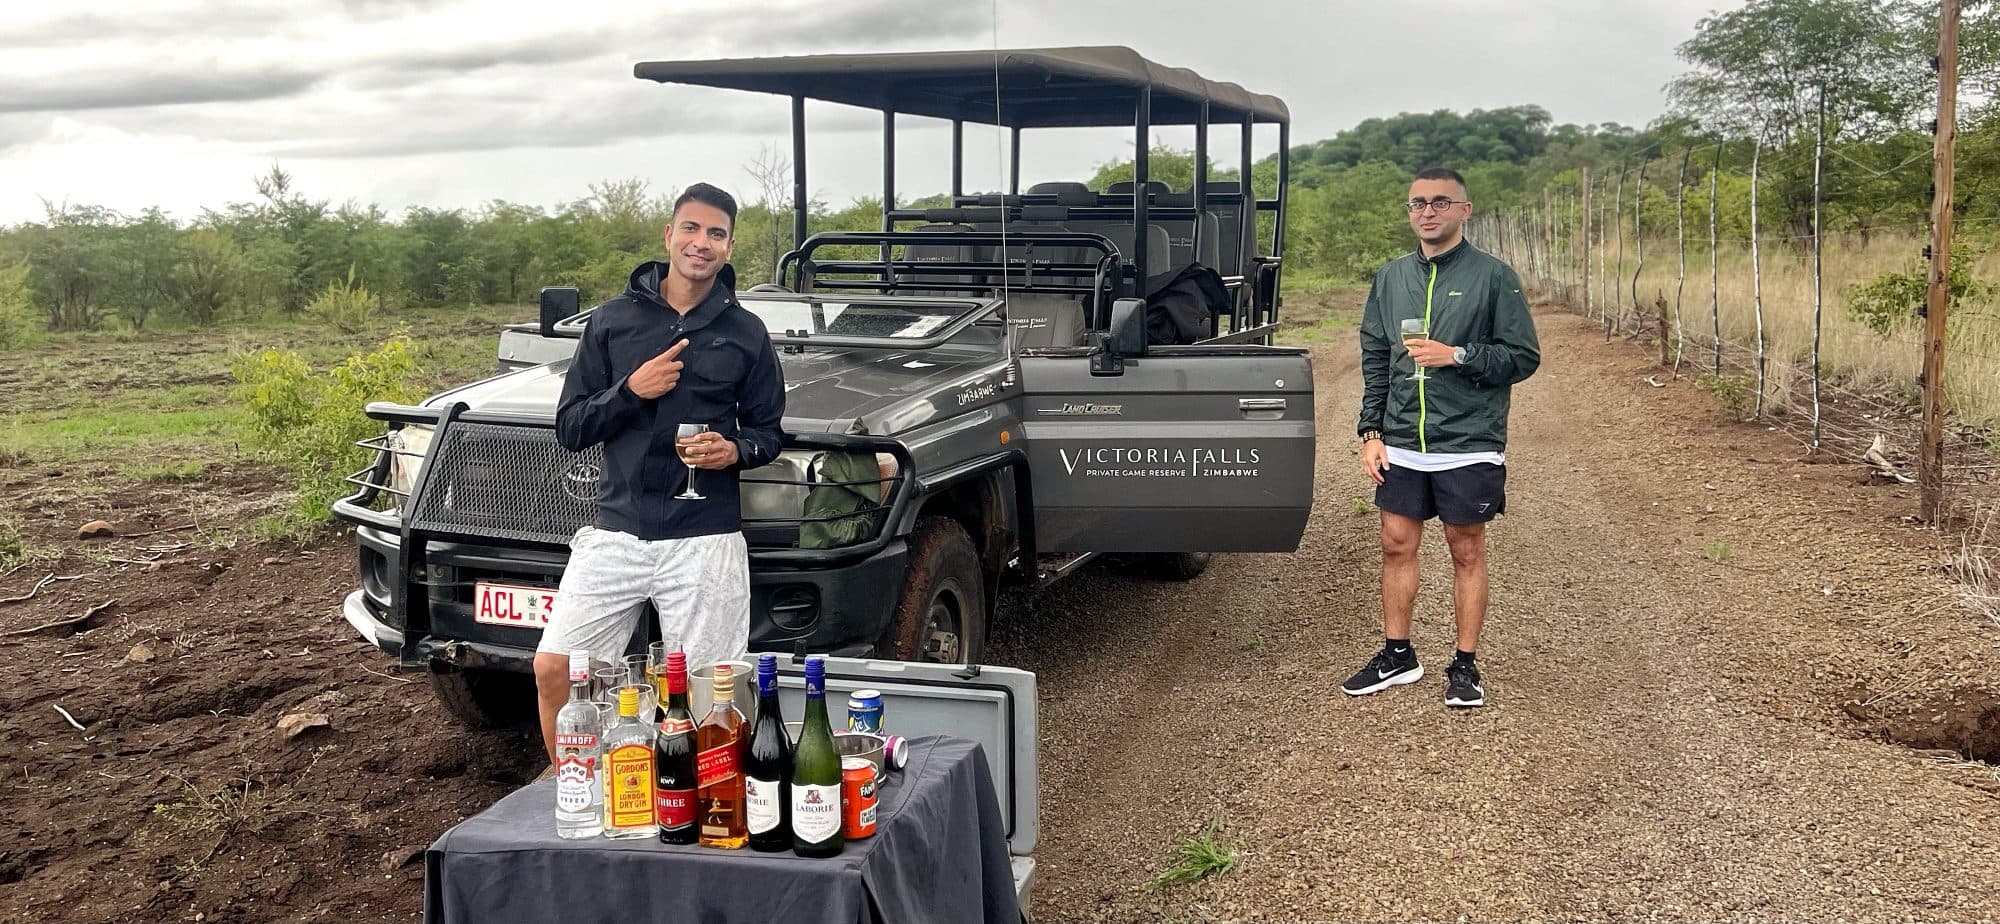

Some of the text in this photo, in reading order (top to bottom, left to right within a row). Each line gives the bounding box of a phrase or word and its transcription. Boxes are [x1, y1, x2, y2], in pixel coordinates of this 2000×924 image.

[957, 384, 995, 406] ZIMBABWE
[1063, 403, 1122, 415] LAND CRUISER
[1060, 448, 1261, 477] VICTORIA FALLS
[1086, 469, 1186, 477] PRIVATE GAME RESERVE
[1203, 469, 1259, 477] ZIMBABWE
[481, 590, 522, 621] ACL
[660, 777, 675, 785] KWV
[619, 791, 646, 801] LONDON
[619, 800, 647, 809] DRY GIN
[656, 796, 685, 808] THREE
[796, 802, 834, 813] LABORIE
